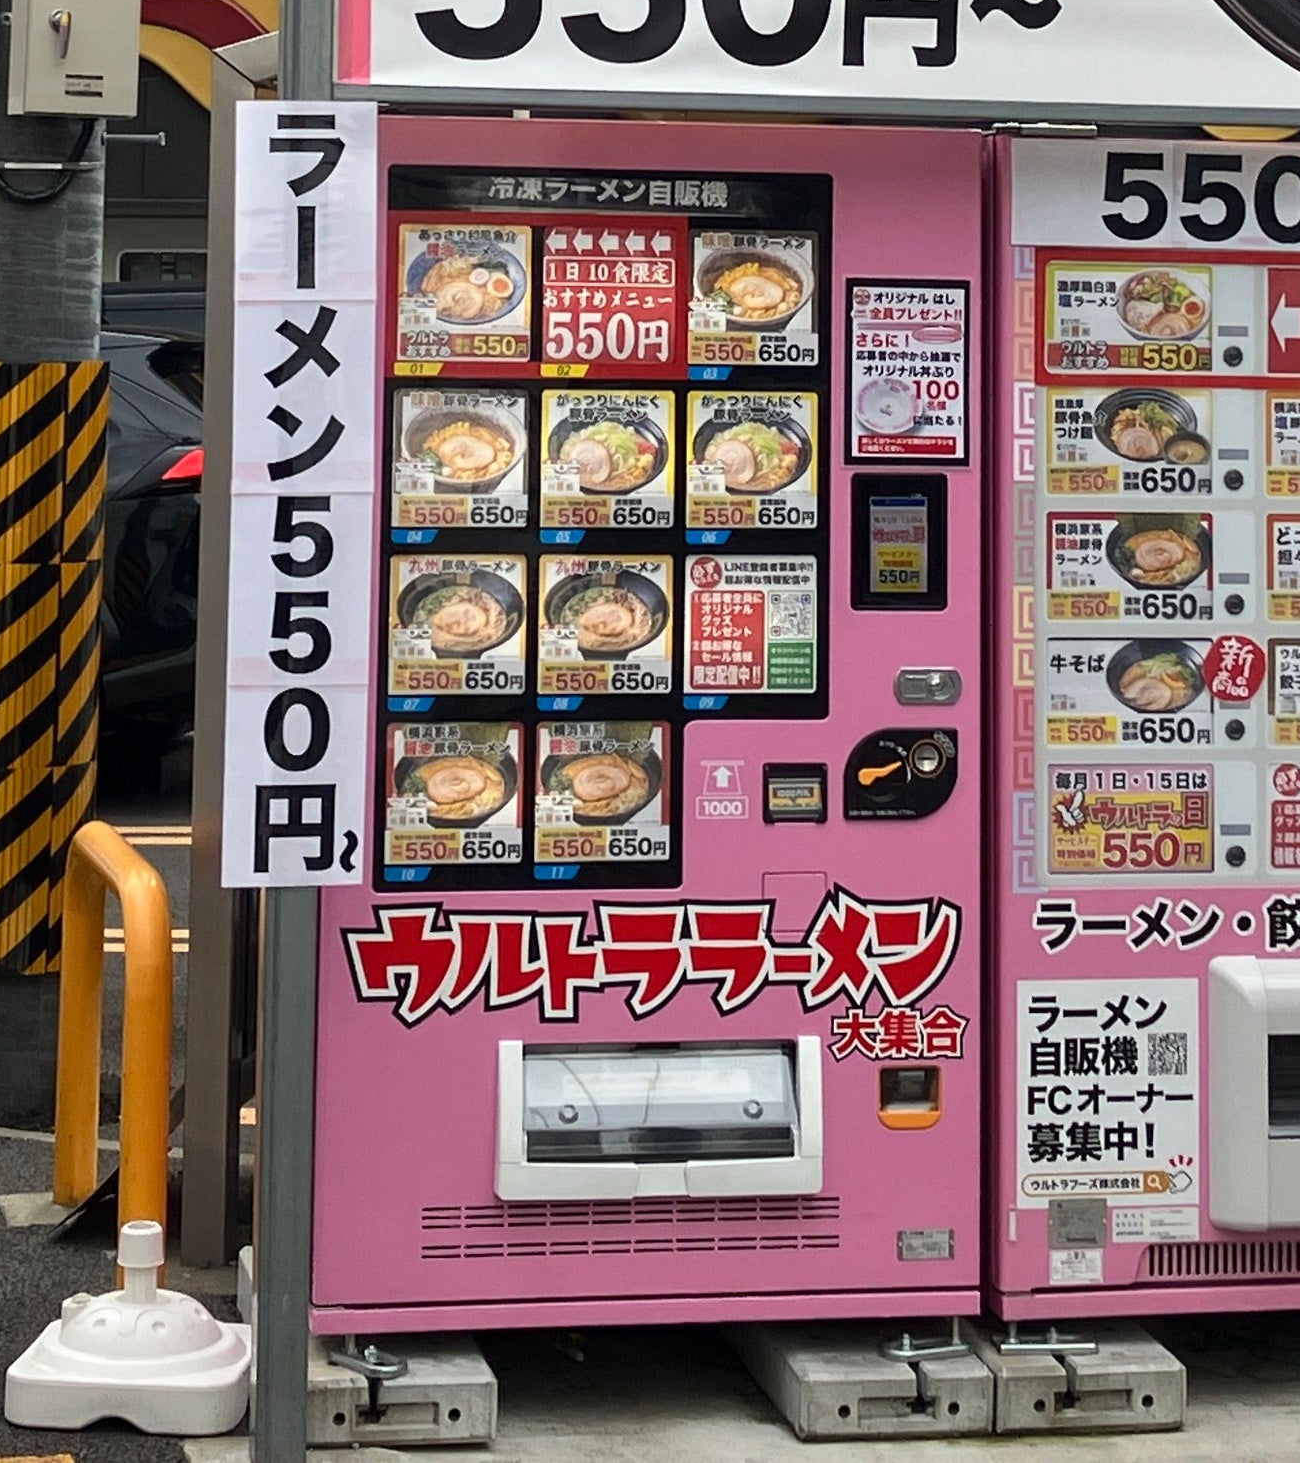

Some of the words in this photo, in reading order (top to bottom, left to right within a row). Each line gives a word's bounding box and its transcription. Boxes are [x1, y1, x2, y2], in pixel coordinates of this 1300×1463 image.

[487, 176, 729, 208] 冷凍ラーメン自販機
[543, 290, 673, 309] おすすめメニュー
[874, 291, 929, 305] オリジナル
[933, 293, 956, 305] はし
[1058, 294, 1120, 308] 塩ラーメン
[473, 335, 527, 356] 550円
[546, 312, 670, 363] 550円
[1061, 340, 1108, 354] ウルトラ
[758, 343, 815, 363] 650円
[1061, 355, 1110, 370] おすすめ
[912, 379, 960, 401] 100
[555, 393, 660, 409] がっつりにんにく
[701, 395, 803, 410] がっつりにんにく
[1141, 467, 1213, 495] 650円
[470, 505, 528, 525] 650円
[612, 505, 670, 526] 650円
[758, 507, 815, 526] 650円
[1055, 553, 1103, 566] ラーメン
[701, 604, 753, 615] オリジナル
[1142, 593, 1214, 621] 650円
[1050, 654, 1105, 674] 牛そば
[464, 670, 524, 690] 650円
[611, 671, 669, 692] 650円
[1140, 718, 1211, 745] 650円
[701, 800, 743, 816] 1000
[462, 839, 521, 860] 650円
[608, 837, 667, 858] 650円
[1102, 831, 1205, 868] 550円
[343, 888, 960, 1026] ウルトララーメン
[1028, 994, 1168, 1033] ラーメン
[830, 1008, 968, 1060] 大集合
[1029, 1036, 1139, 1078] 自販機
[1027, 1083, 1194, 1116] FCオーナー
[1030, 1178, 1141, 1191] ウルトラフーズ株式会社
